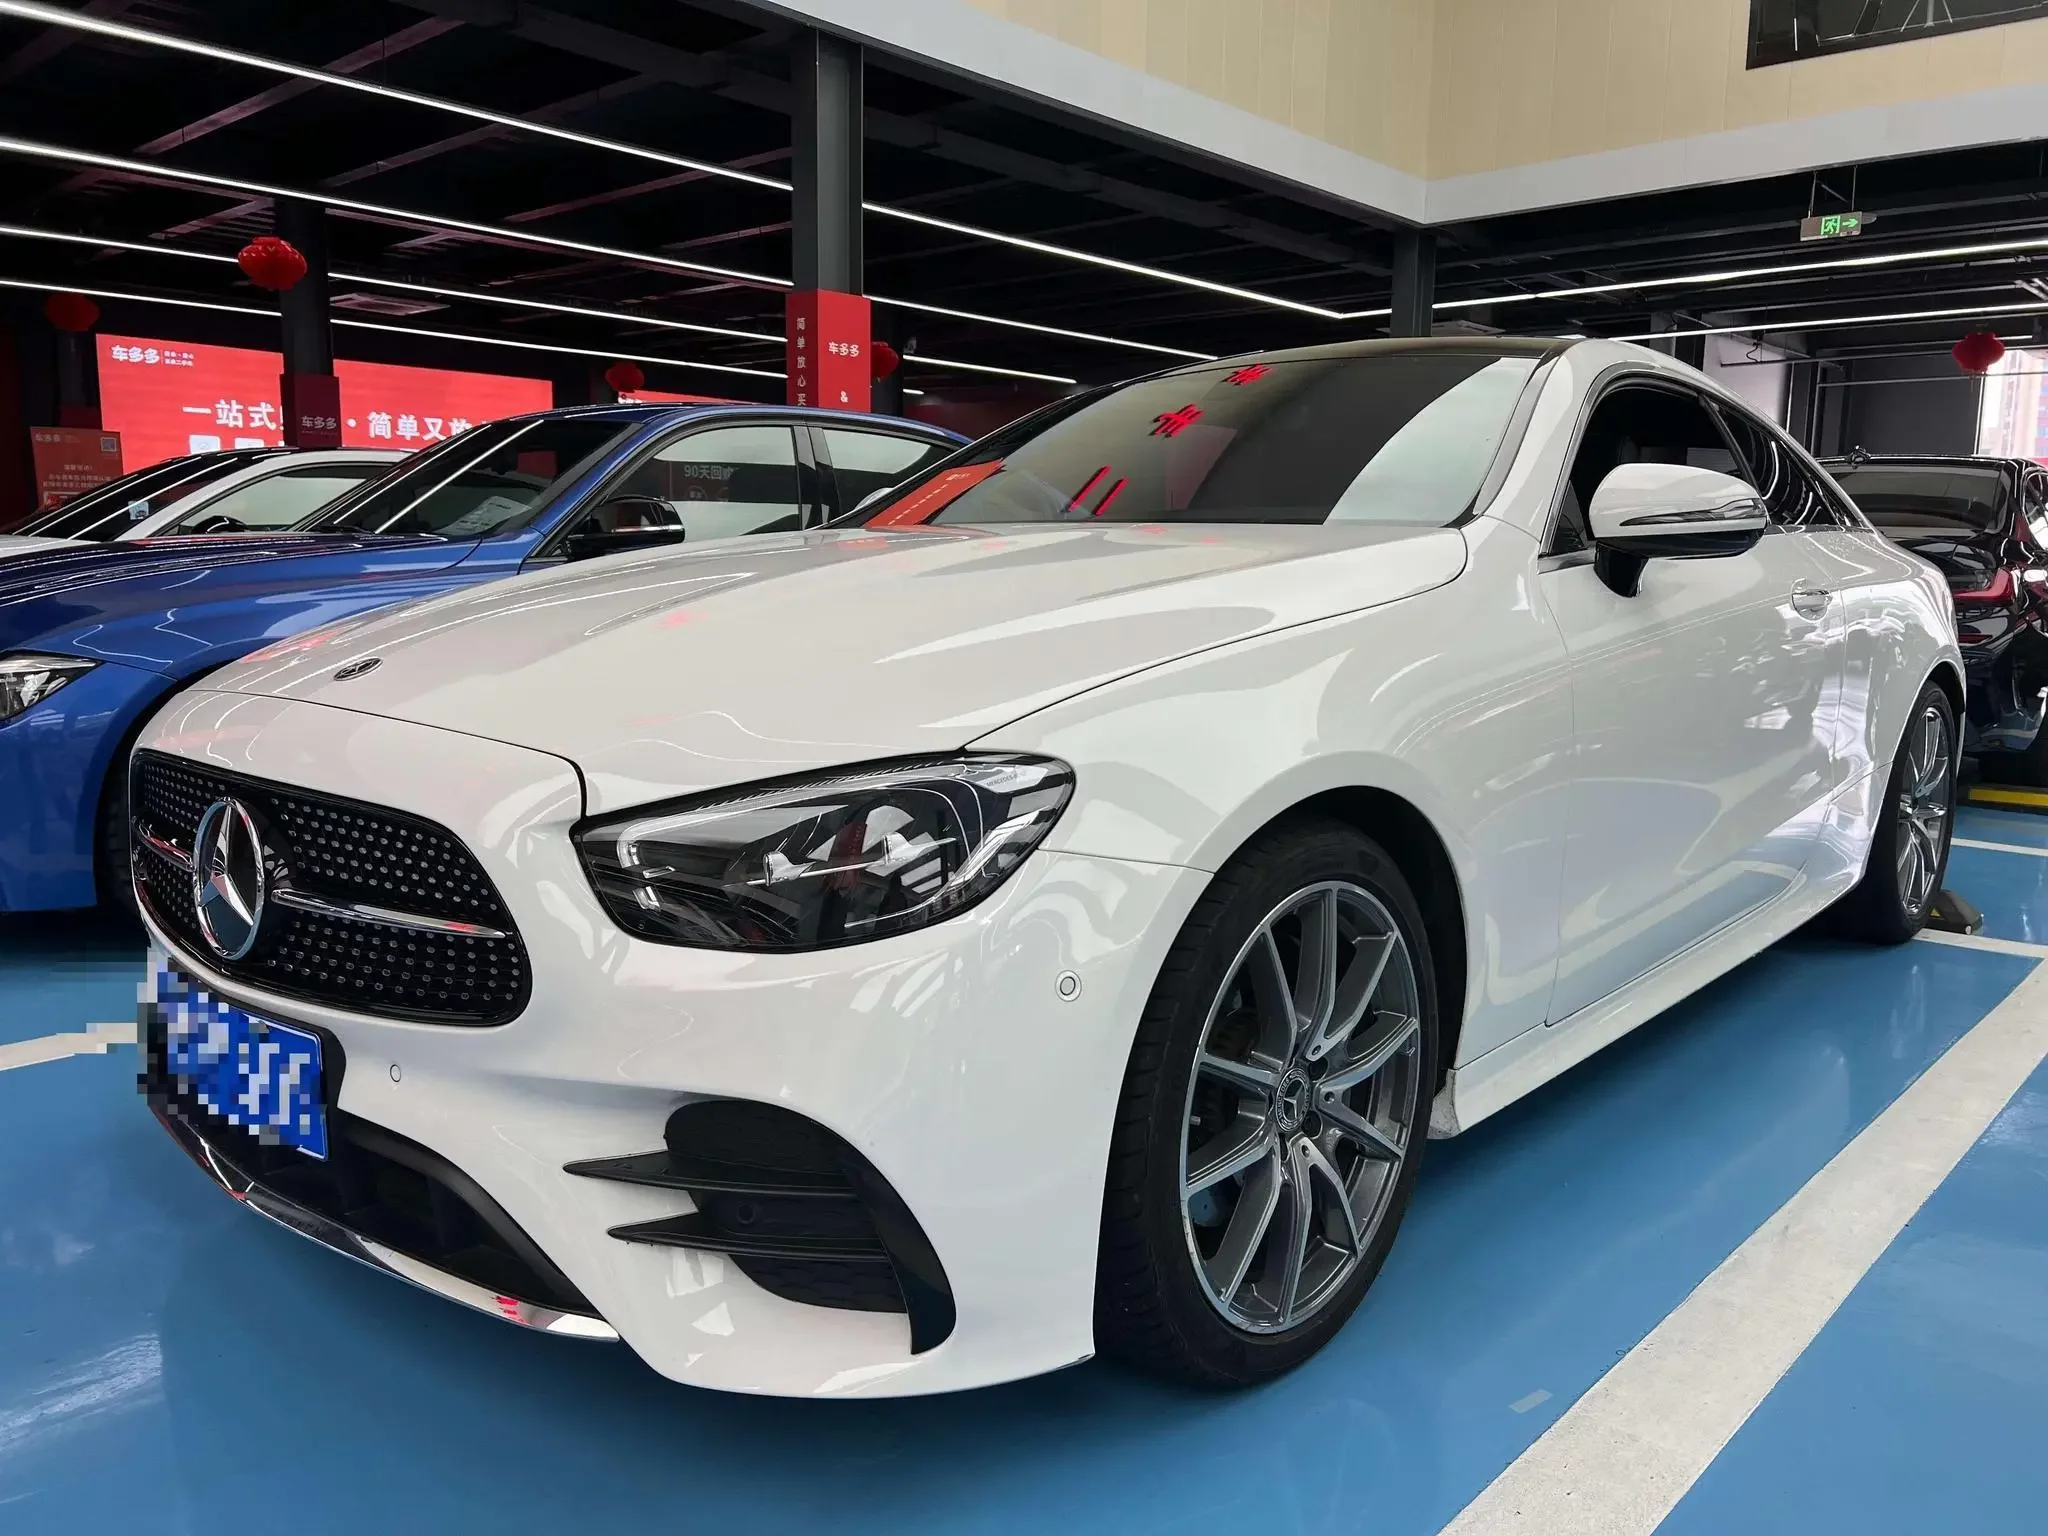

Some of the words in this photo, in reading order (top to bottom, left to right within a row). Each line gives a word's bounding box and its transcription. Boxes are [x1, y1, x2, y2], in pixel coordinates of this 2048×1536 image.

[111, 345, 160, 364] 车多多
[828, 341, 860, 357] 车多多
[182, 399, 284, 430] 一站式
[301, 416, 337, 430] 车多多
